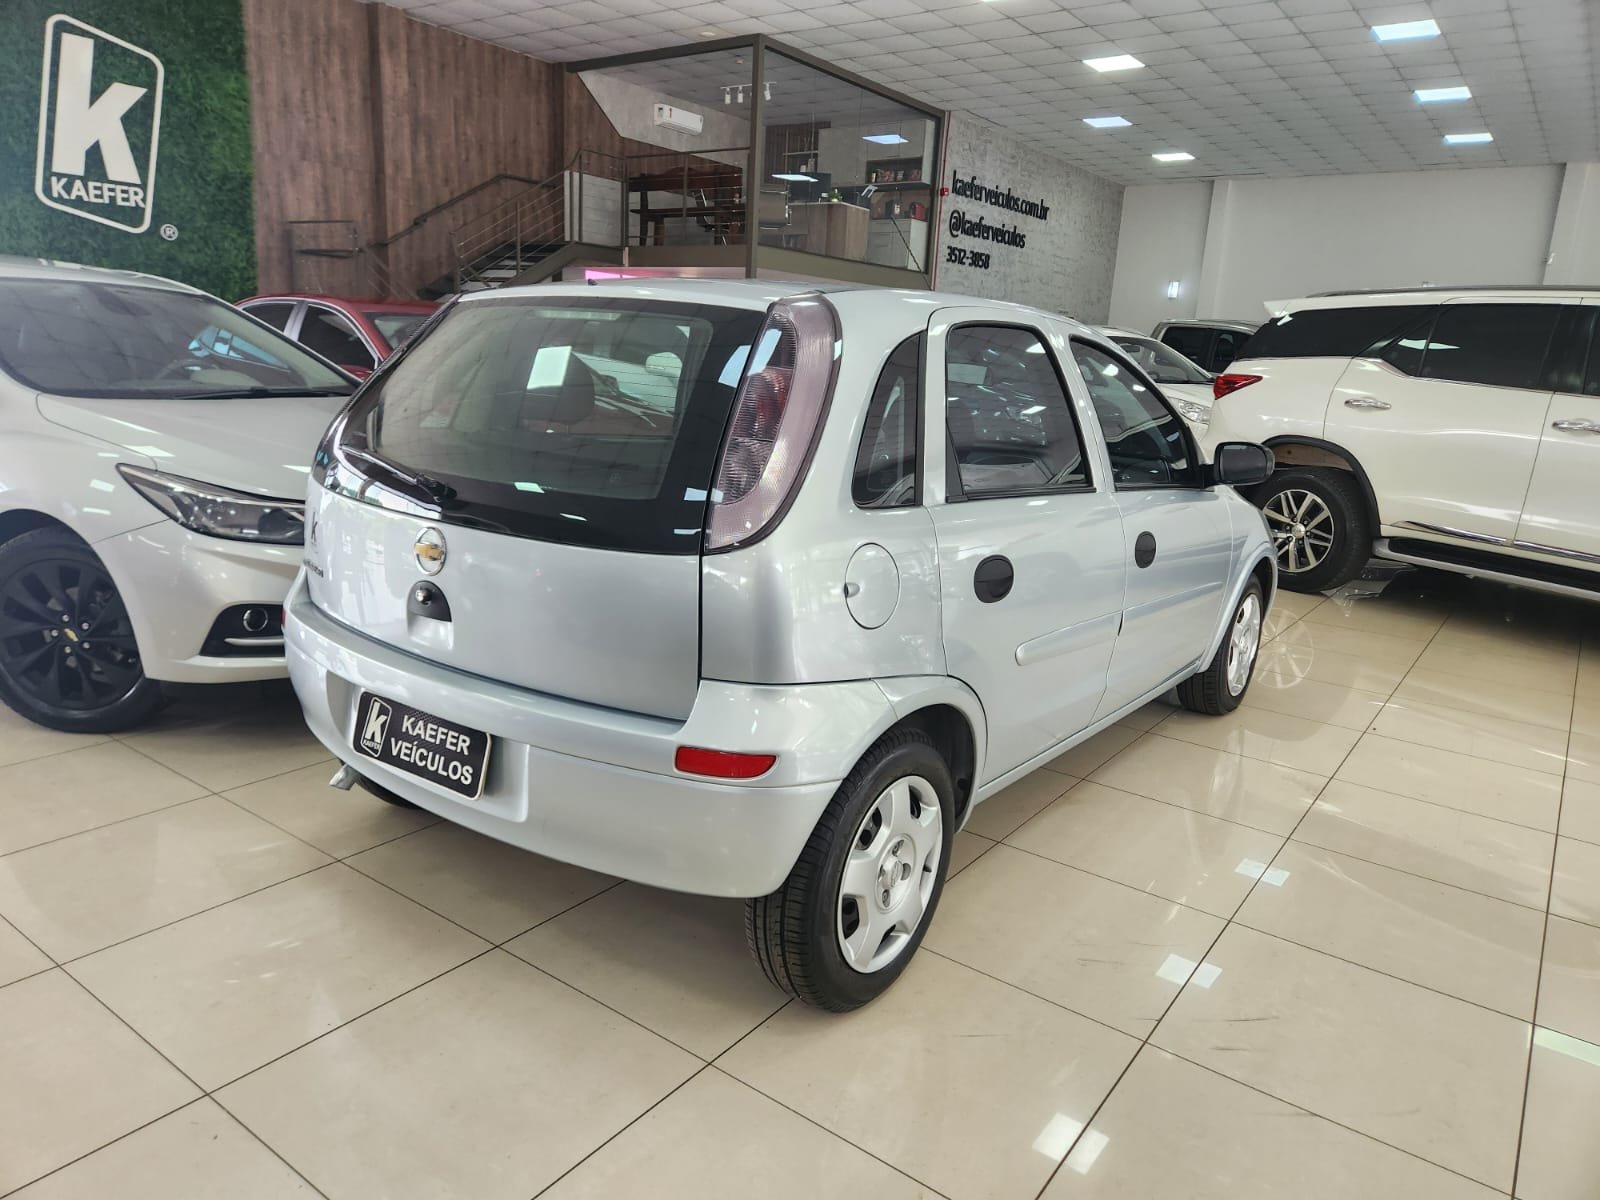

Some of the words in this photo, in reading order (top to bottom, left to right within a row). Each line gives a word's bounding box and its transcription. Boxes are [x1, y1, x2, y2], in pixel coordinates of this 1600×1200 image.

[50, 175, 145, 208] KAEFER
[951, 169, 1050, 220] kaeferveiculos.com.br
[949, 209, 1026, 249] @kaeferveiculos
[946, 245, 991, 270] 3512-3058
[402, 715, 471, 756] KAEFER
[390, 737, 474, 785] VEÍCULOS
